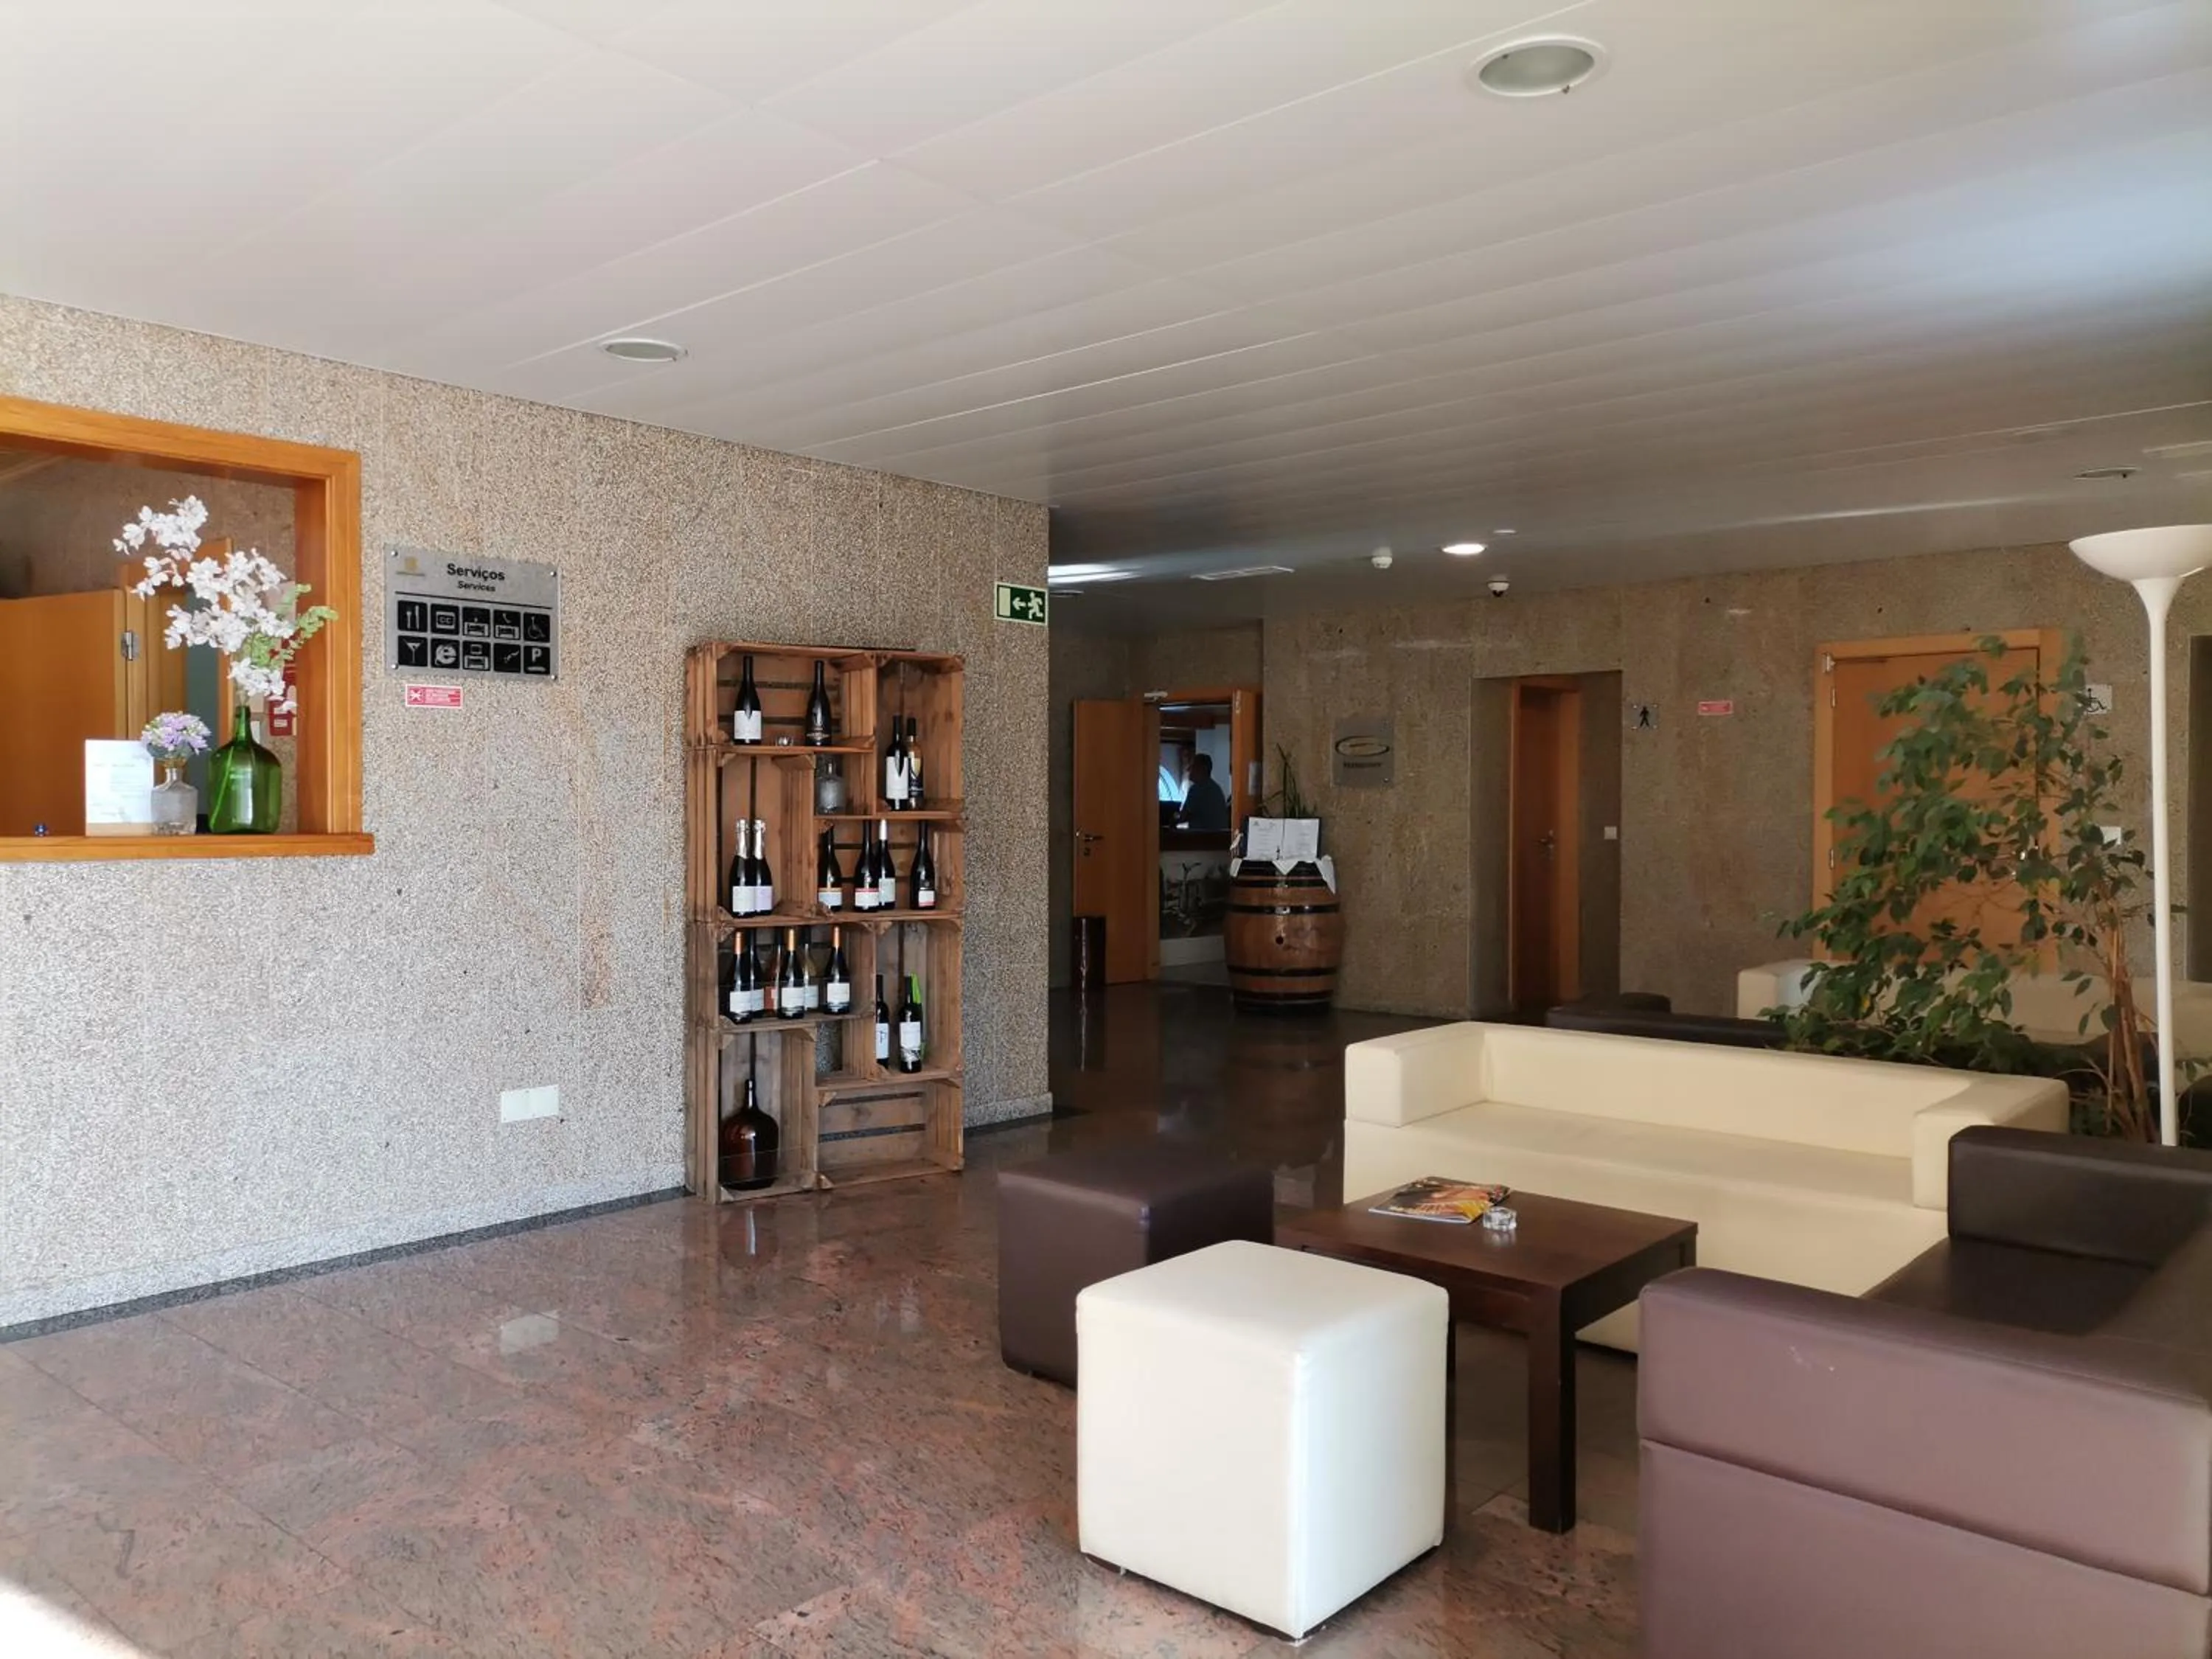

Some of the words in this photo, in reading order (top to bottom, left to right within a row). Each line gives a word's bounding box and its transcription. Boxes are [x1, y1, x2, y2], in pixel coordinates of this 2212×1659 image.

[447, 563, 505, 581] Serviços
[458, 580, 496, 592] Services
[532, 647, 542, 662] P
